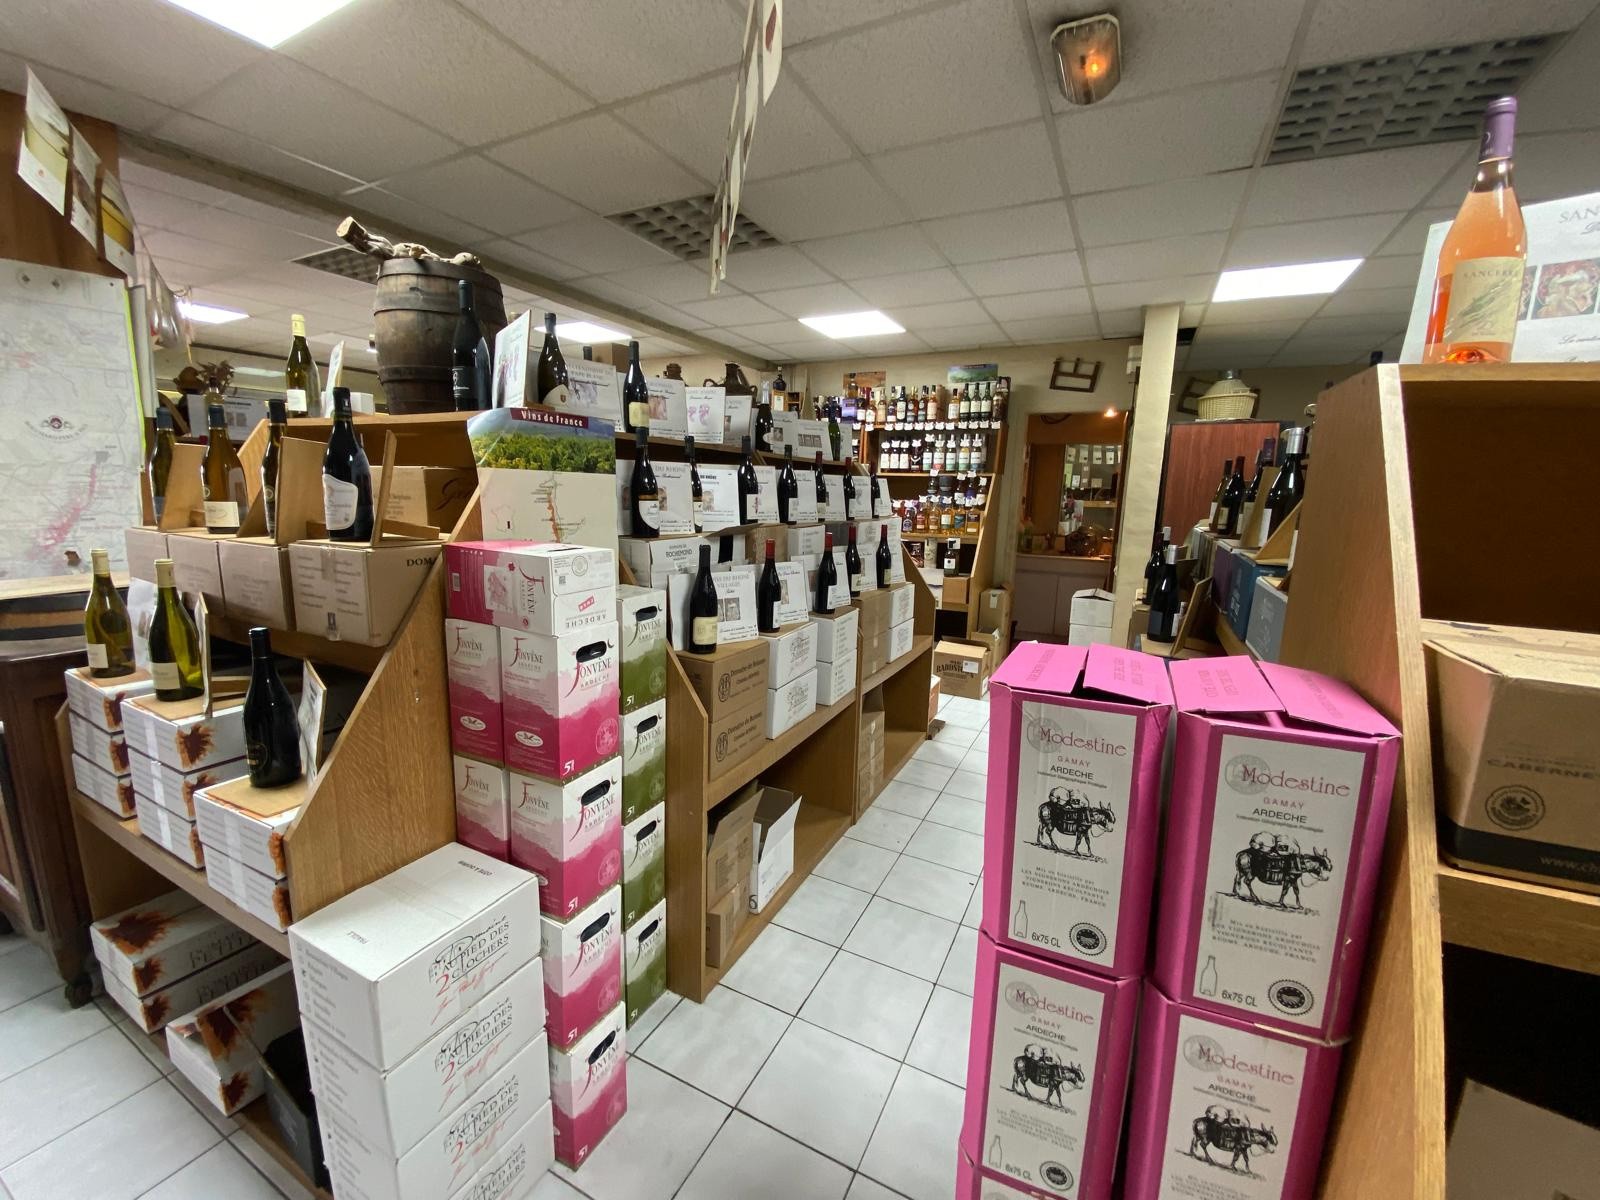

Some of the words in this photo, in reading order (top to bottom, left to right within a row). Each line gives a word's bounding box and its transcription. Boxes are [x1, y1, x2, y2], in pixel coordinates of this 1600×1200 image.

[521, 409, 543, 422] Vins
[544, 413, 554, 423] de
[1040, 727, 1127, 757] Modestine
[1057, 755, 1091, 768] GAMAY
[1050, 765, 1095, 780] ARDECHE
[1241, 763, 1351, 797] Modestine
[1263, 797, 1305, 810] GAMAY
[1252, 808, 1308, 824] ARDECHE
[460, 938, 487, 960] PIED
[490, 921, 510, 941] DES
[1031, 932, 1050, 945] 6x75
[1050, 937, 1061, 948] CL
[435, 973, 450, 998] 2
[1015, 989, 1095, 1025] Modestine
[1221, 989, 1243, 1003] 6x75
[1245, 995, 1258, 1007] CL
[1025, 1024, 1066, 1041] ARDECHE
[1198, 1042, 1295, 1085] Modestine
[441, 1061, 455, 1086] 2
[1208, 1083, 1256, 1103] ARDECHE
